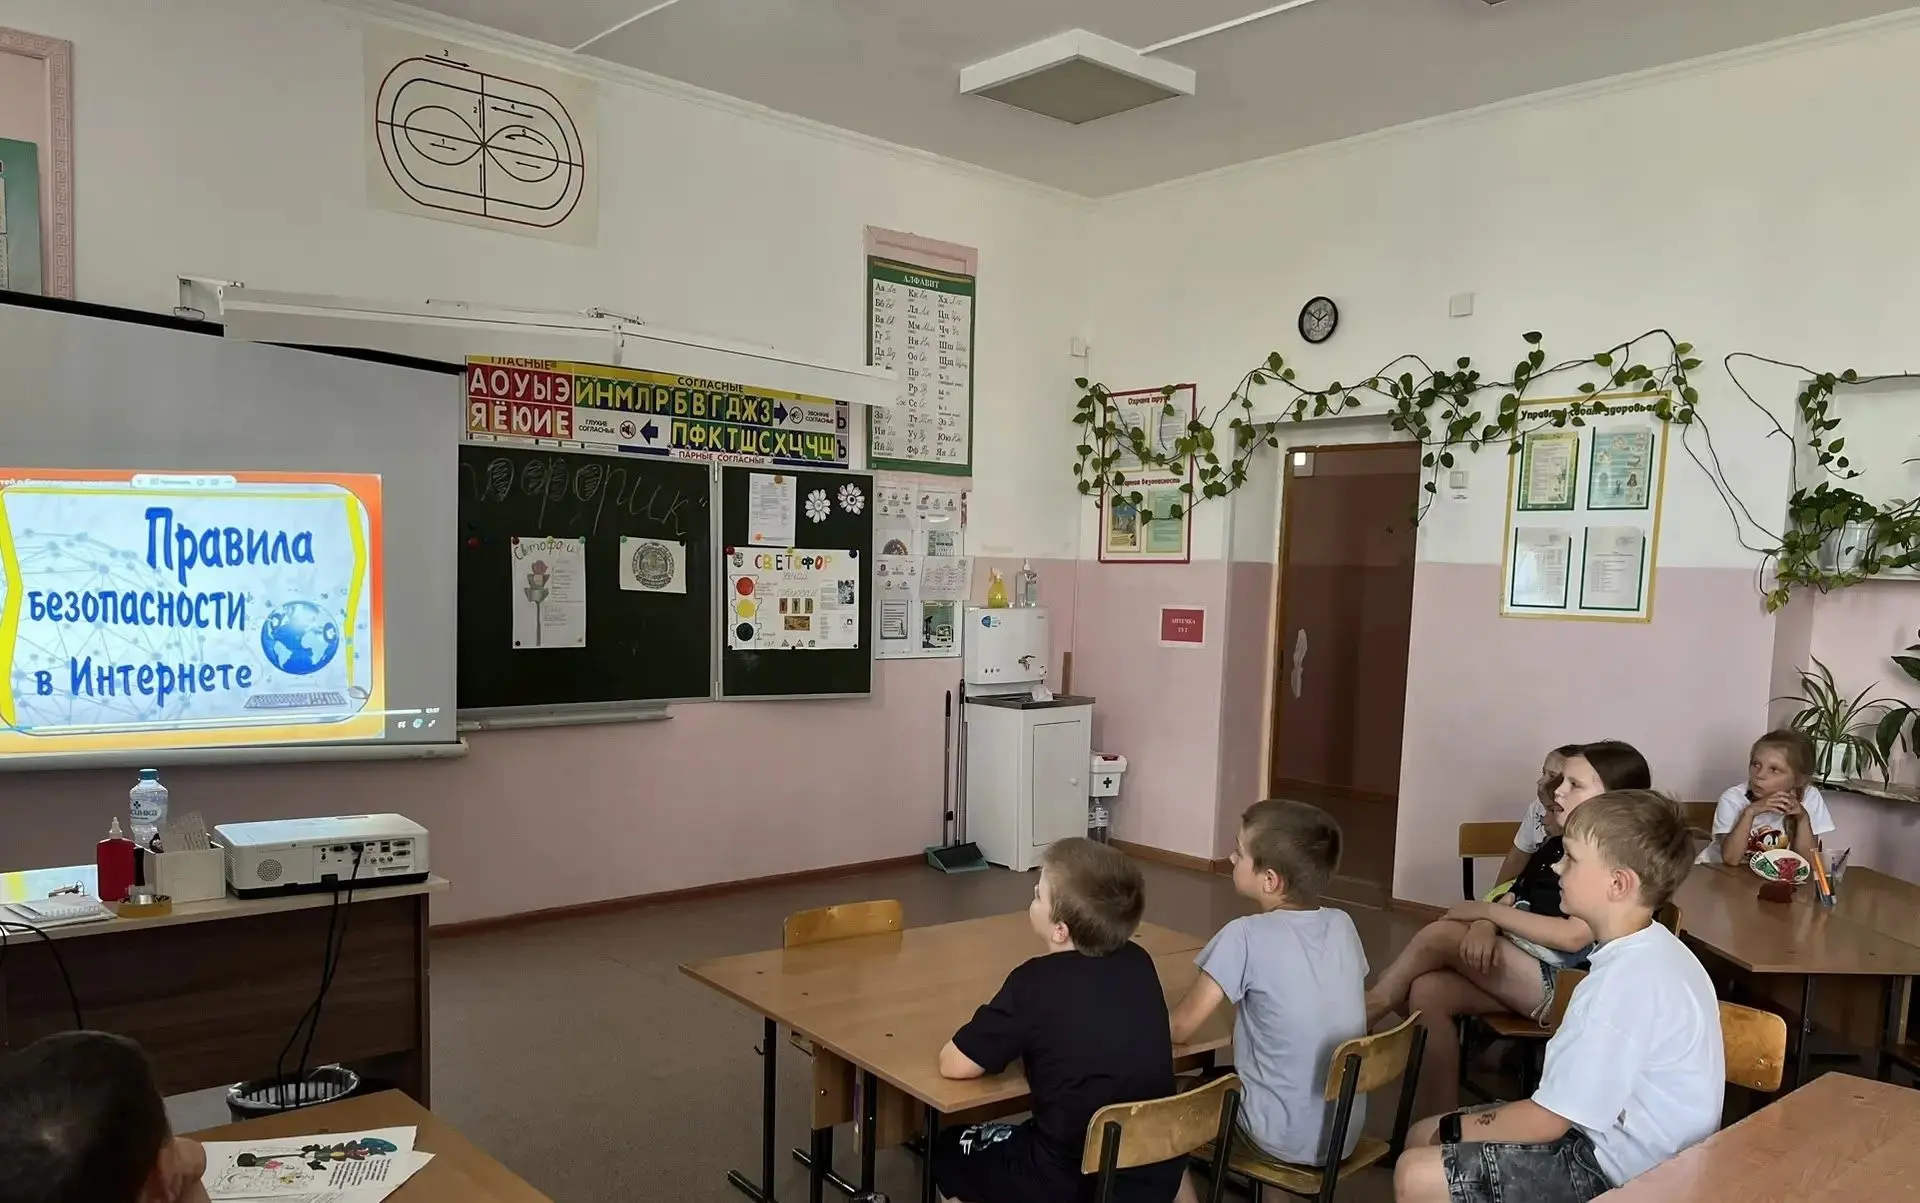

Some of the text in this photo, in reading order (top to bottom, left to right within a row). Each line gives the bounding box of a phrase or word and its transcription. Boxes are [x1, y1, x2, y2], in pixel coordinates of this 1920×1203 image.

[903, 275, 940, 288] АЛФАВИТ
[677, 376, 745, 393] СОГЛАСНЫЕ
[679, 451, 766, 465] ПАРНЫЕ СОГЛАСНЫЕ
[145, 507, 315, 587] Правила
[754, 554, 832, 571] СВЕТОФОР
[34, 655, 253, 708] в Интернете
